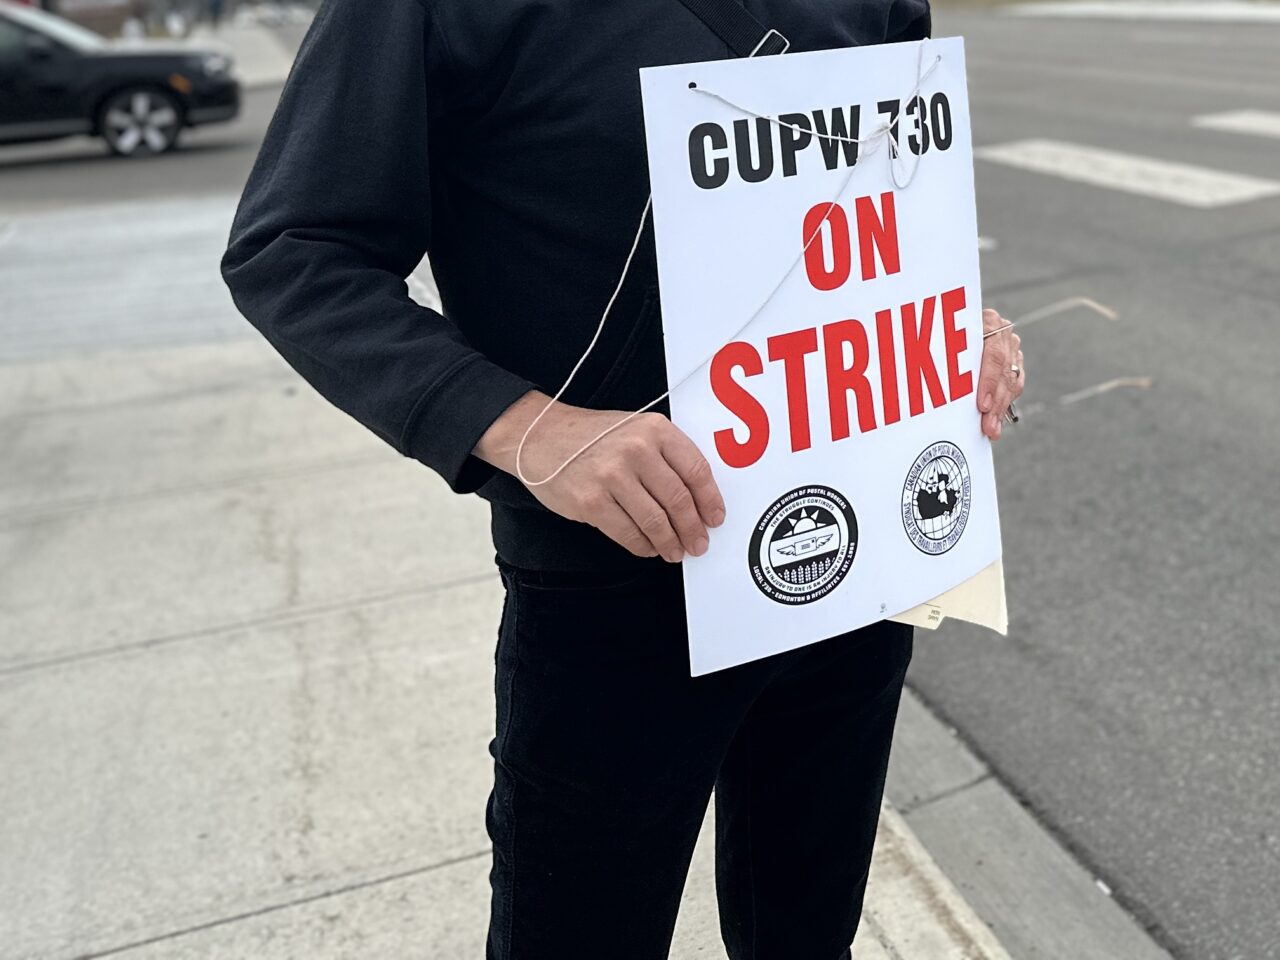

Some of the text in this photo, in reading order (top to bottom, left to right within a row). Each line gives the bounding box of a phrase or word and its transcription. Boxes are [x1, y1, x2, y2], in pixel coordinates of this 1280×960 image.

[688, 92, 953, 190] CUPW 730
[802, 191, 901, 292] ON
[709, 286, 974, 469] STRIKE
[906, 462, 922, 491] CANADIAN
[758, 502, 782, 531] CANADIAN
[780, 492, 799, 505] UNION
[807, 488, 826, 496] POSTAL
[826, 490, 848, 510] WORKERS
[770, 498, 835, 528] THE STRUGGLE CONTINUES
[753, 565, 763, 584] LOCAL
[774, 591, 806, 603] EDMONTON
[811, 576, 841, 600] AFFILIATES
